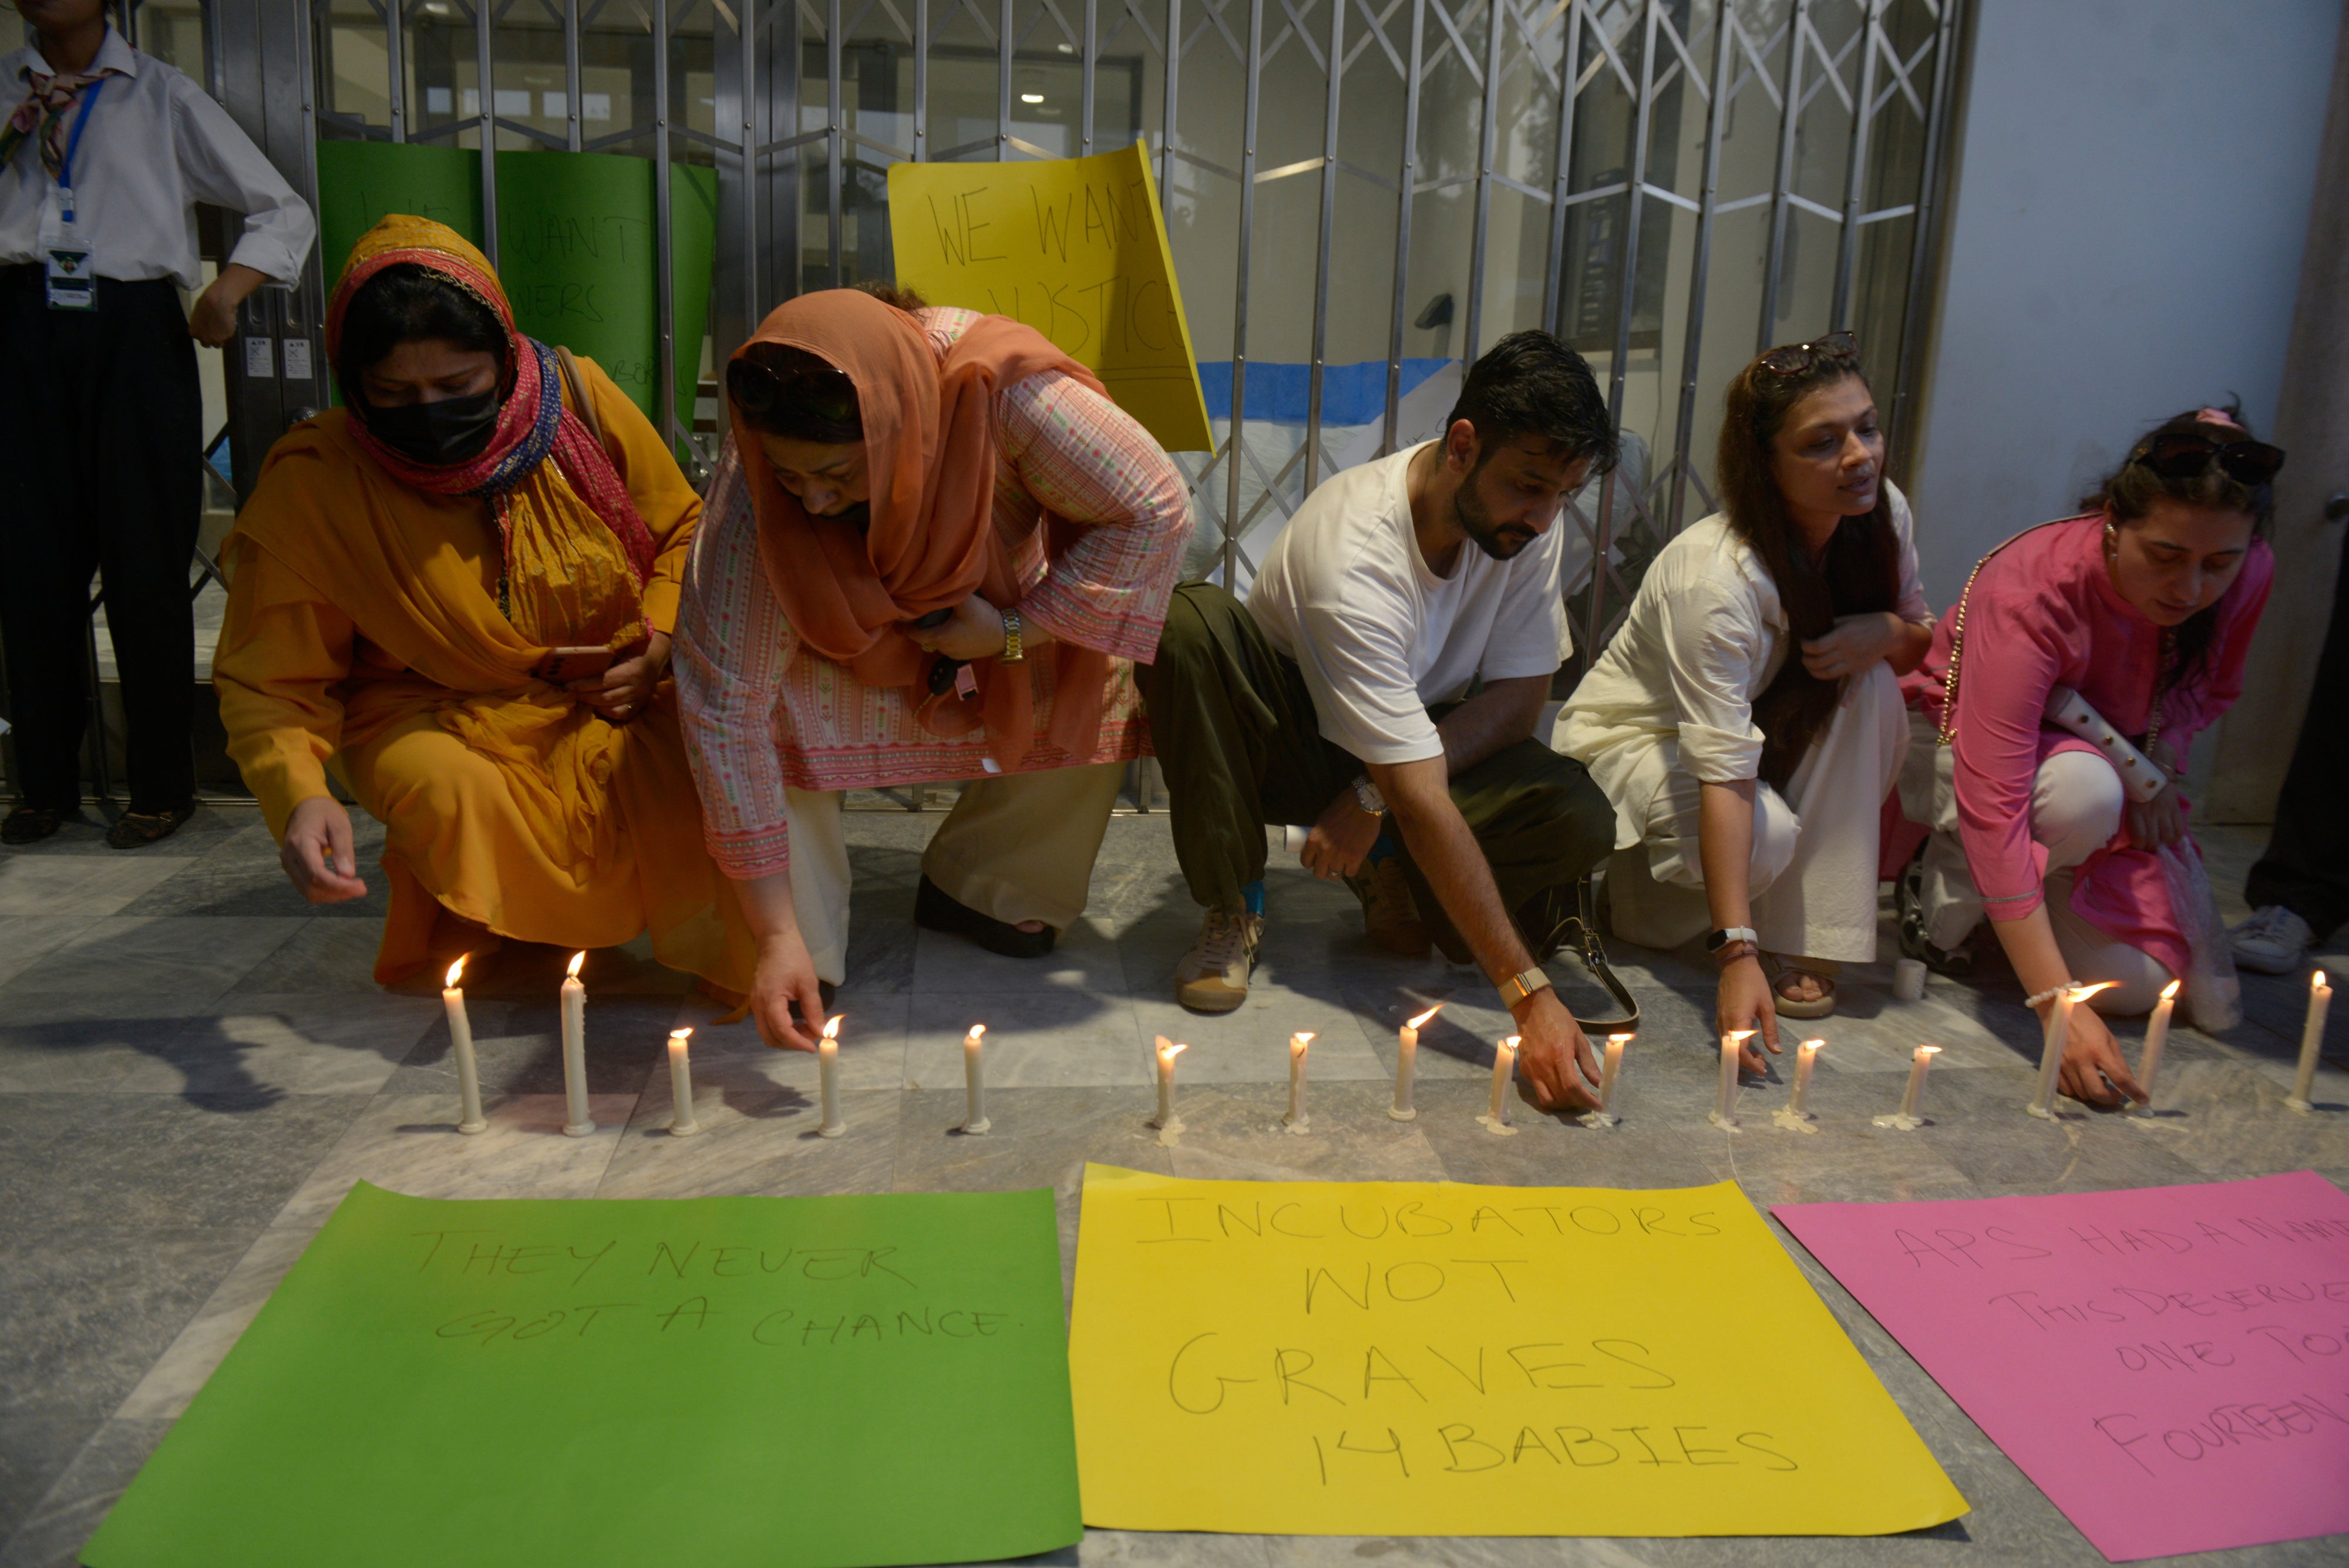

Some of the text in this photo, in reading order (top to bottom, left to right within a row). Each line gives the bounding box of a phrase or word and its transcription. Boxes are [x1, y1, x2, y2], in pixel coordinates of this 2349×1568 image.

[507, 211, 648, 265] WANT
[927, 186, 1008, 267] WE
[1136, 1197, 1721, 1243] INCUBATORS
[1894, 1226, 2052, 1269] APS
[2068, 1224, 2193, 1255] HAD
[2195, 1220, 2247, 1247] A
[410, 1230, 918, 1290] THEY NEVER
[1305, 1260, 1529, 1314] NOT
[435, 1303, 642, 1347] GOT
[656, 1296, 724, 1333] A
[2115, 1324, 2349, 1373] ONE TO
[1169, 1333, 1677, 1414] GRAVES
[1313, 1423, 1798, 1486] 14 BABIES
